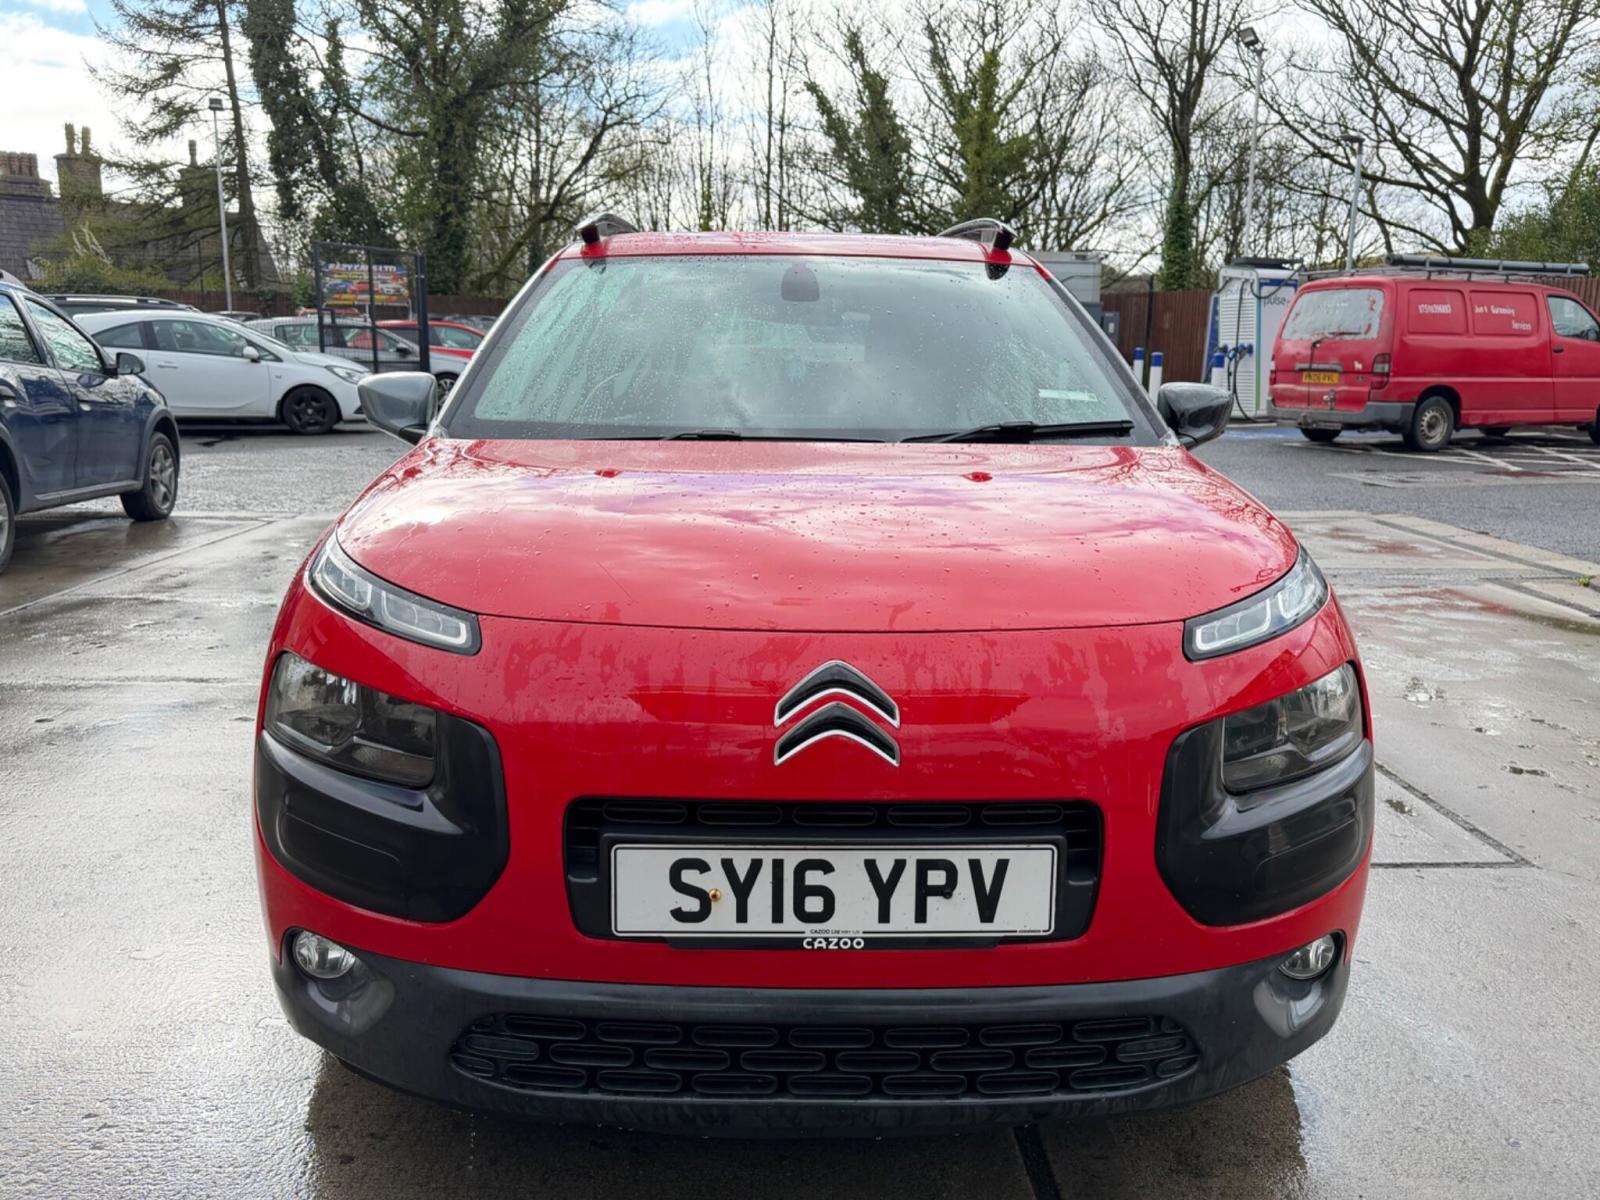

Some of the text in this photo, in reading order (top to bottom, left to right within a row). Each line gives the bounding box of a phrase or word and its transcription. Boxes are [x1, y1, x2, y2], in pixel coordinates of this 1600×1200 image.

[669, 858, 1010, 924] SY16 YPV
[803, 938, 865, 949] CAZOO
